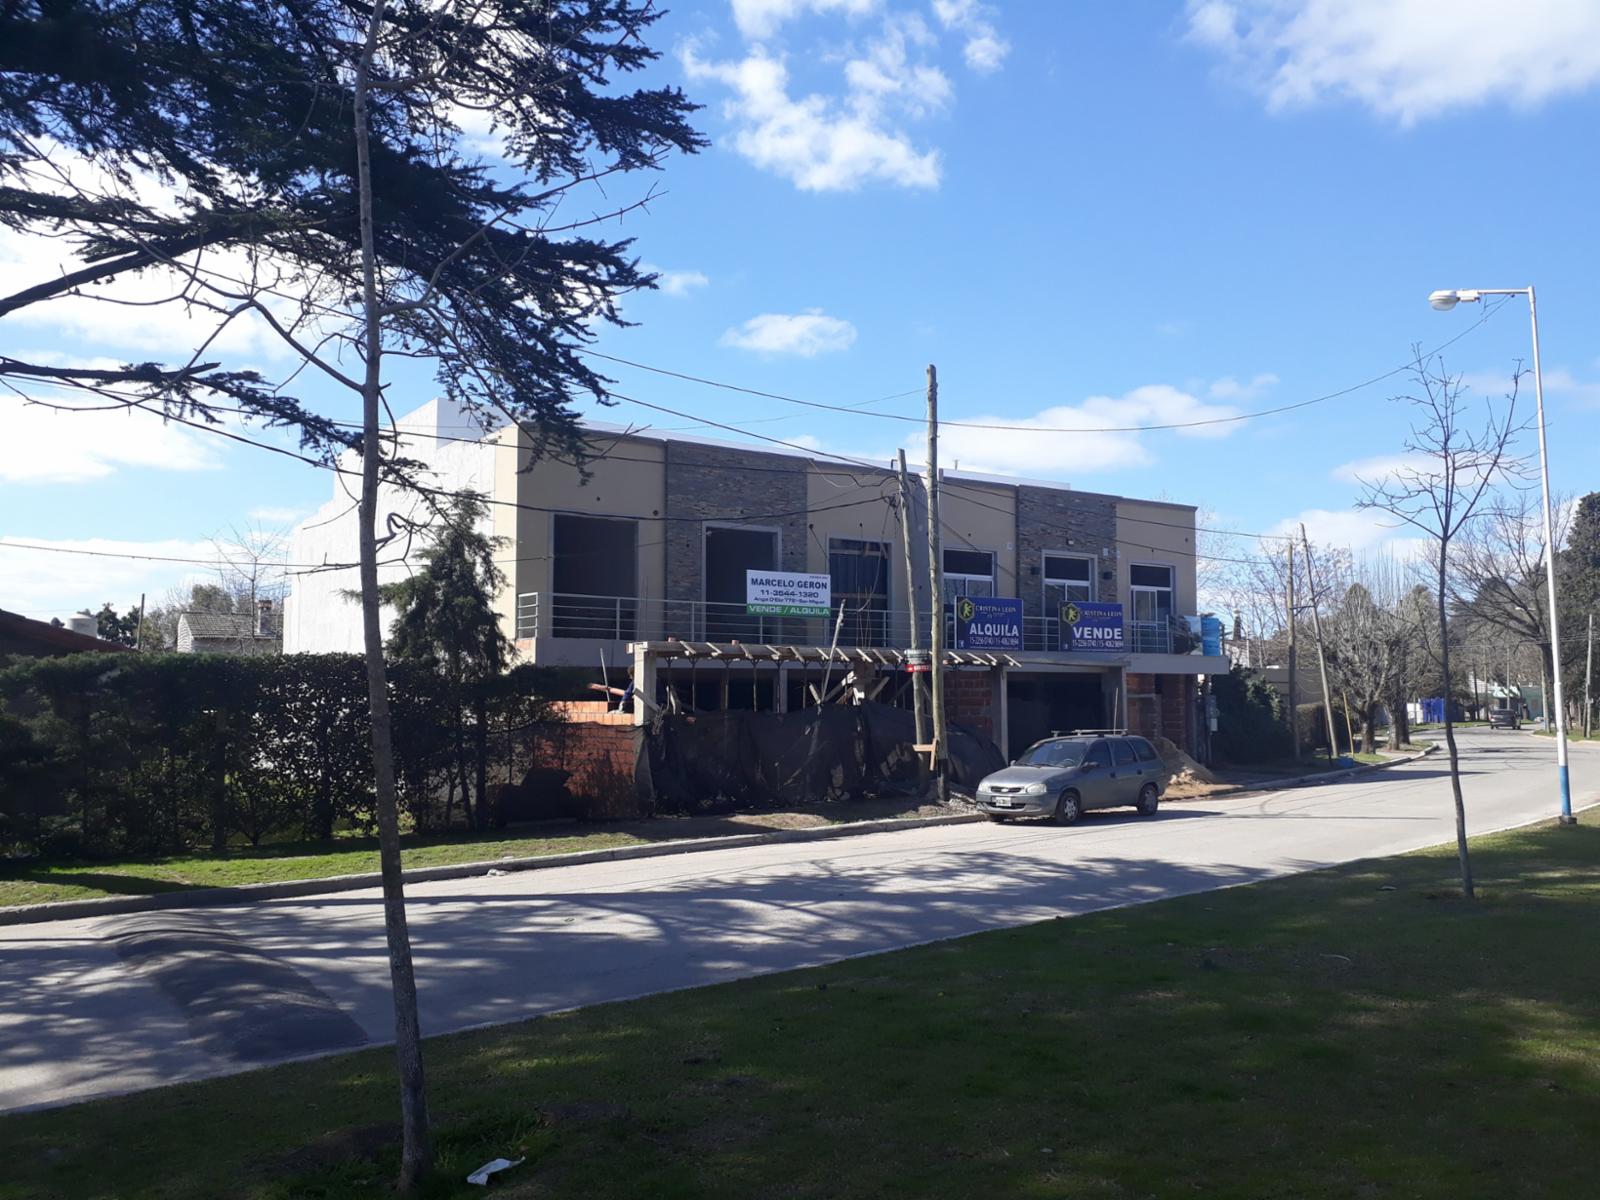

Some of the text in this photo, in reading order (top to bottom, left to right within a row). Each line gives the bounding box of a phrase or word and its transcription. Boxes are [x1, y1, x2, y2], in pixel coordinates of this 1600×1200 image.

[751, 578, 827, 589] MARCELO GERON
[749, 605, 782, 613] VENDE
[790, 607, 829, 615] ALQUILA
[969, 623, 1019, 636] ALQUILA
[1073, 627, 1122, 640] VENDE
